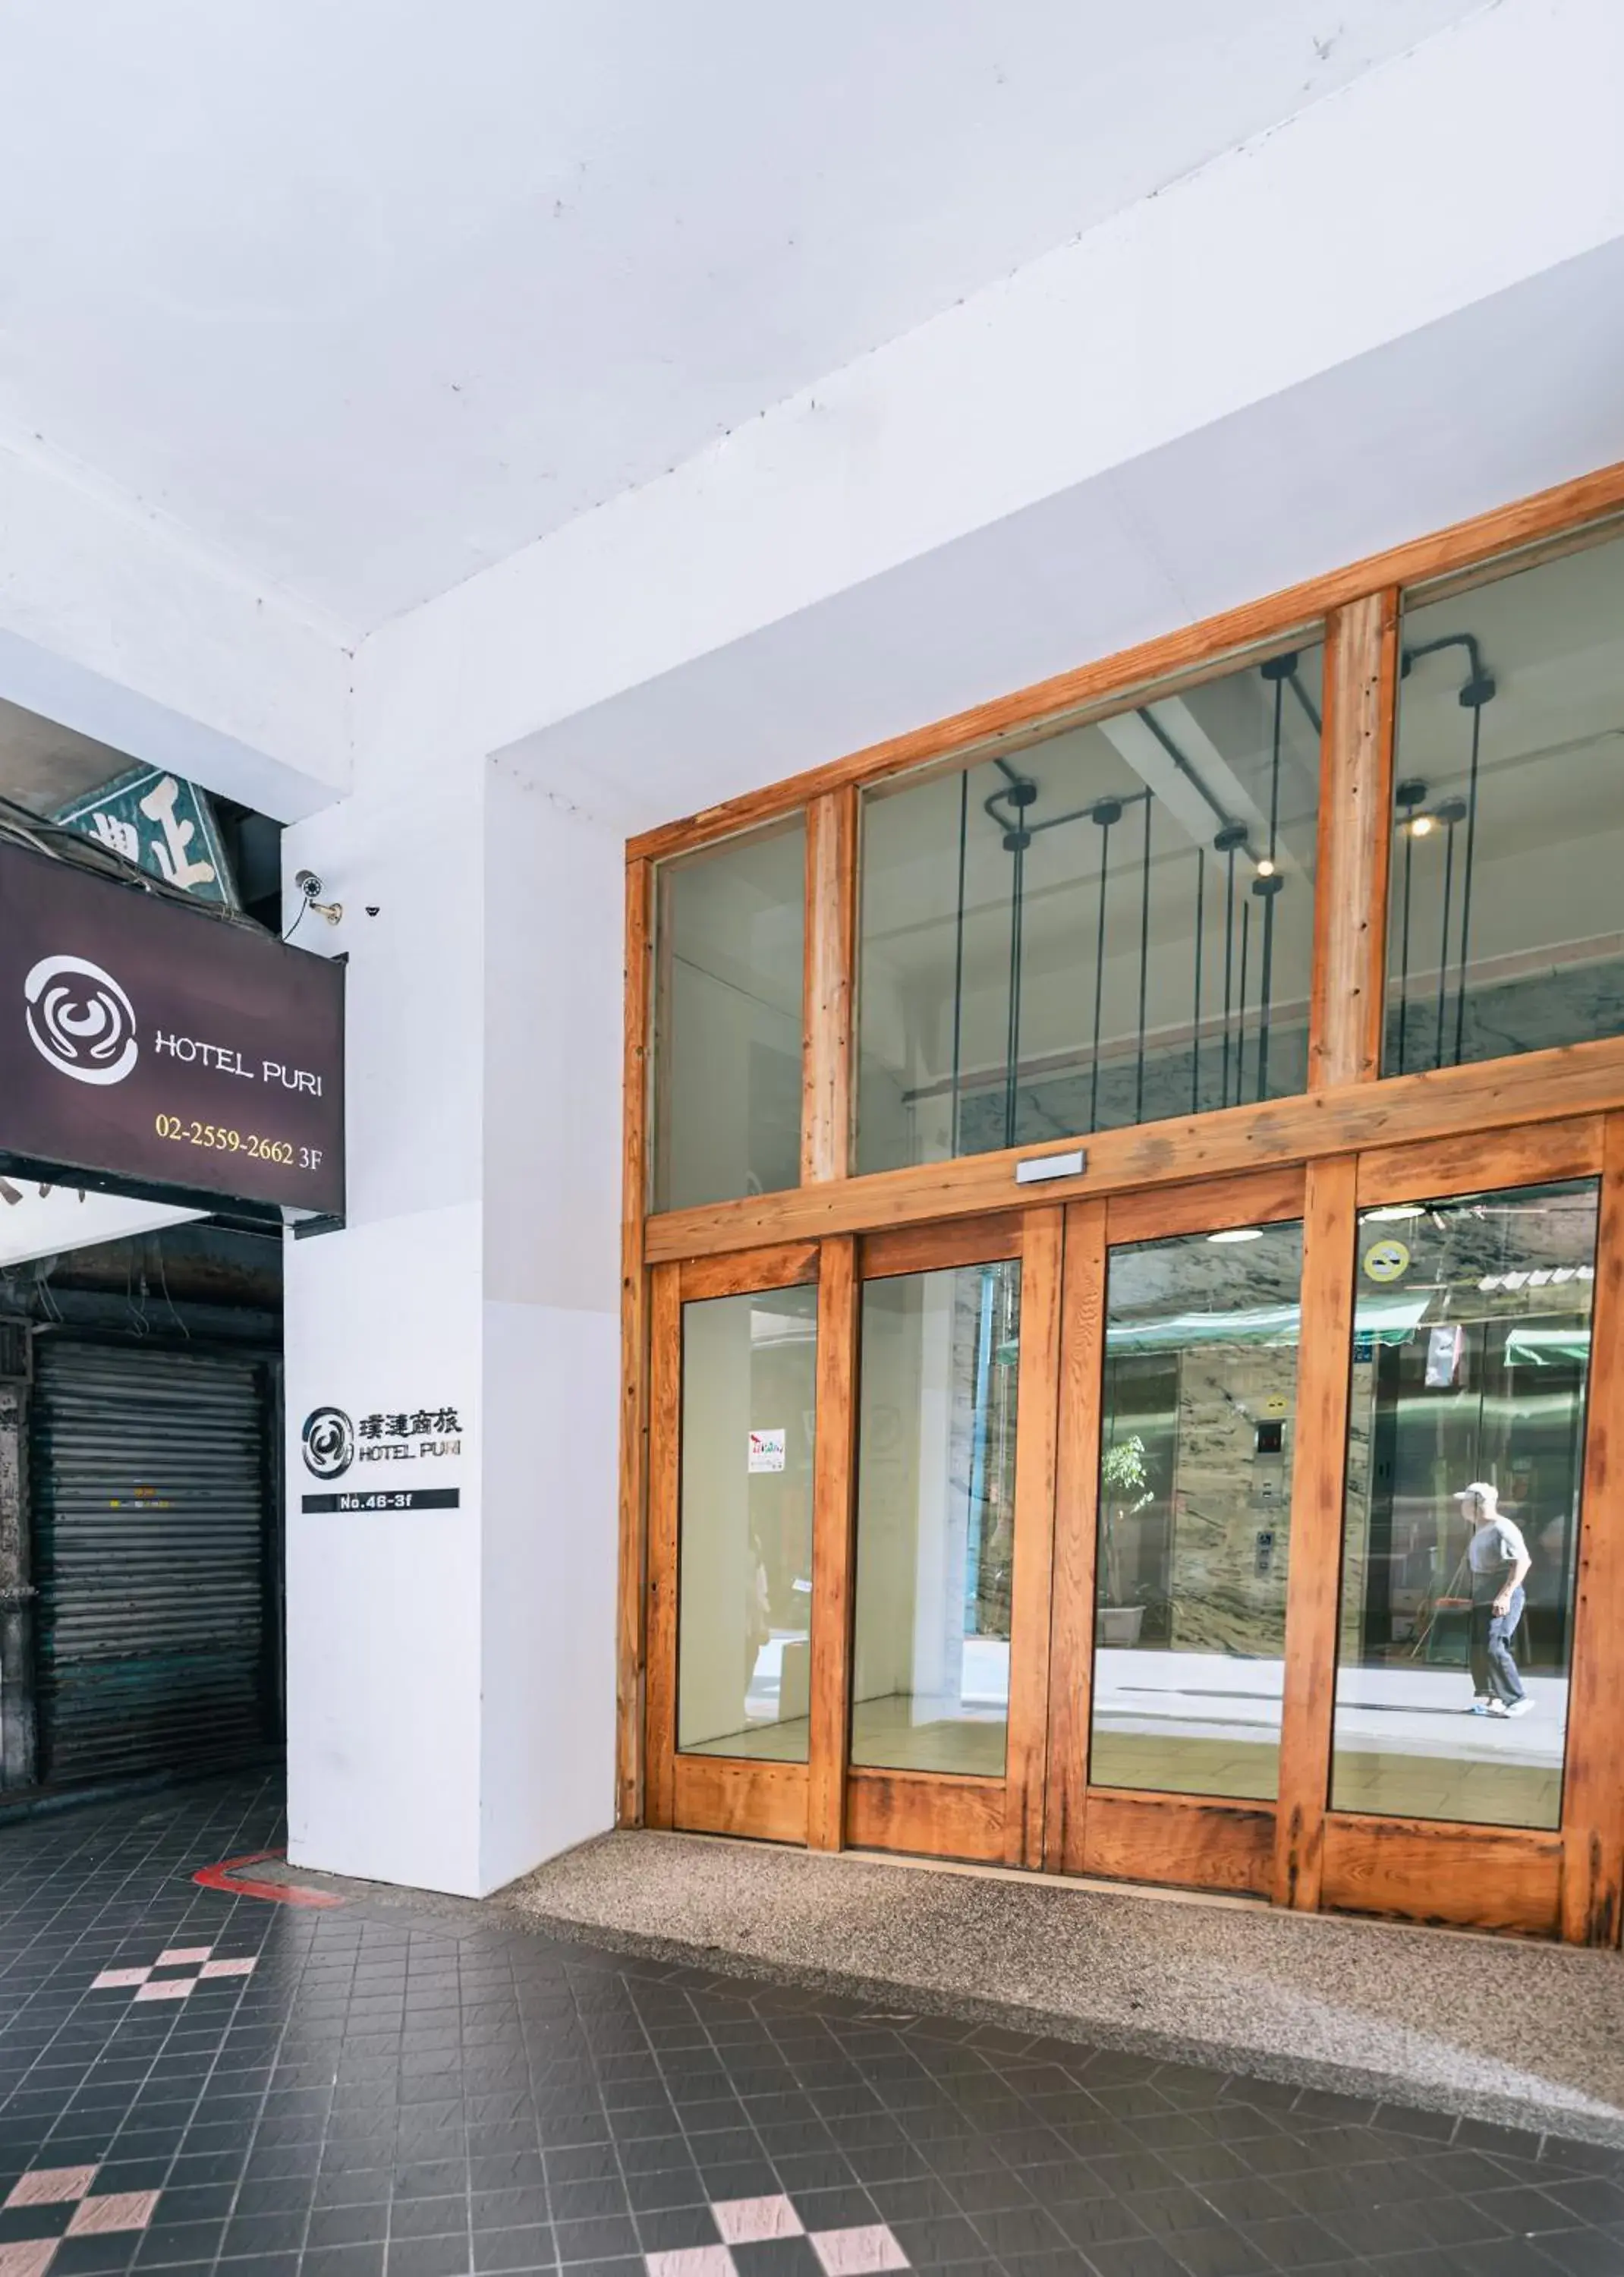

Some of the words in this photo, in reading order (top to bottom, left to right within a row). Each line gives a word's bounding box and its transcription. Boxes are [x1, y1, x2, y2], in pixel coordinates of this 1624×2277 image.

[155, 1030, 254, 1079] HOTEL
[262, 1060, 323, 1097] PURI
[155, 1113, 294, 1164] 02-2559-2662
[299, 1147, 323, 1170] 3F
[359, 1444, 416, 1462] HOTEL
[420, 1440, 461, 1457] PURI
